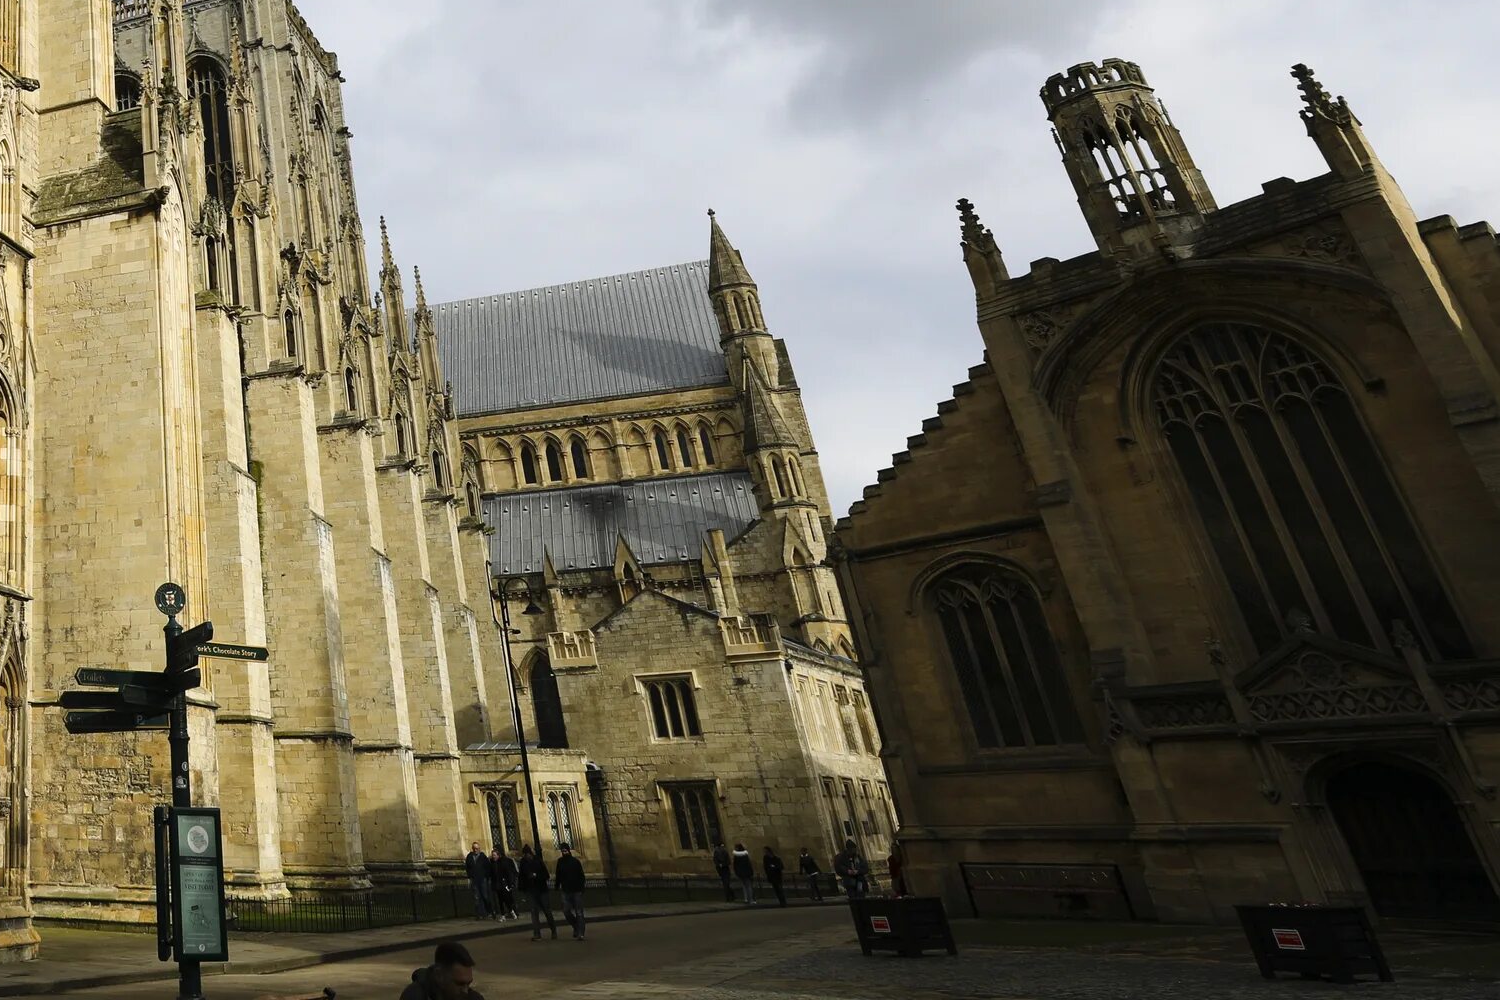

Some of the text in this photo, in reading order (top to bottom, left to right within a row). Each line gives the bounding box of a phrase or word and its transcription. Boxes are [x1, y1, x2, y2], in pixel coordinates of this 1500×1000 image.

[212, 646, 240, 656] Chocolate
[241, 649, 257, 659] Story
[82, 671, 106, 683] Toilets
